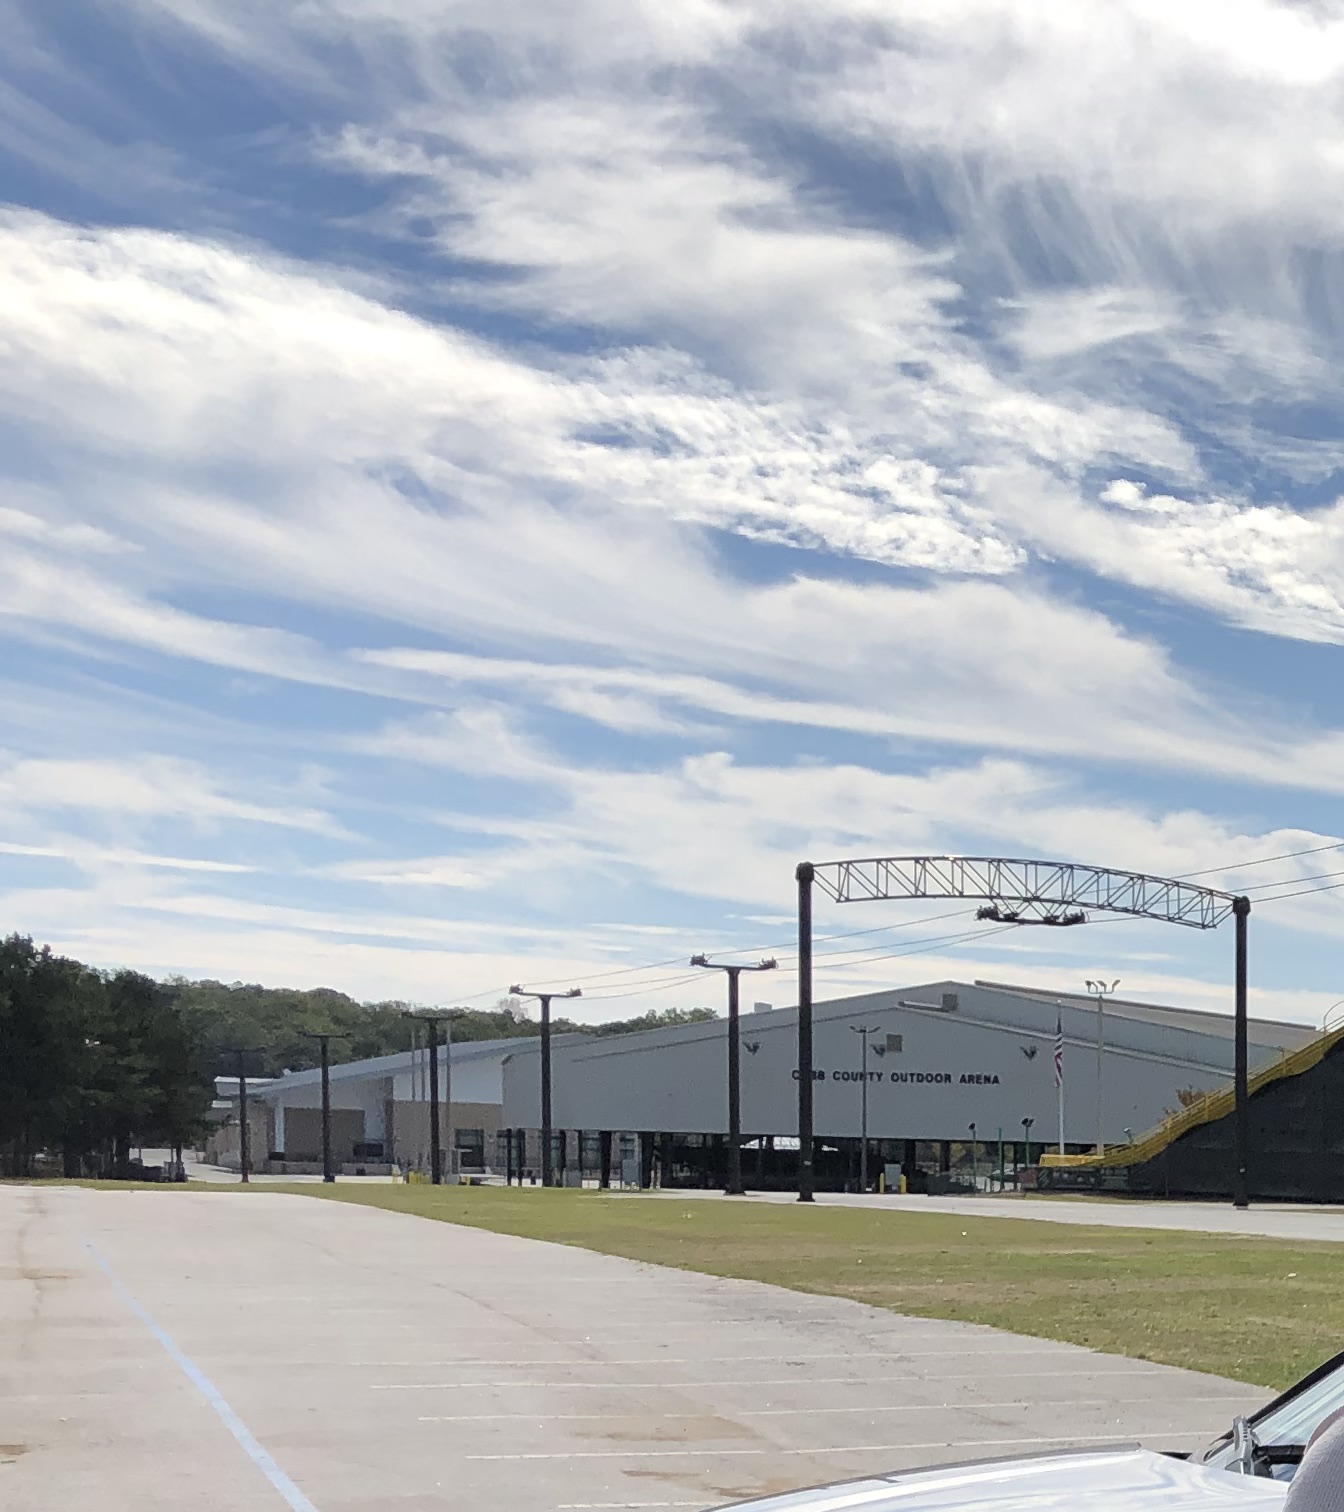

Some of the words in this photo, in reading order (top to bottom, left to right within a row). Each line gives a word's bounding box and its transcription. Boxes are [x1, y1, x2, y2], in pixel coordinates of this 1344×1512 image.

[791, 1070, 825, 1081] CBB
[832, 1070, 884, 1082] COUNTY
[890, 1071, 952, 1084] OUTDOOR
[958, 1073, 1000, 1085] ARENA
